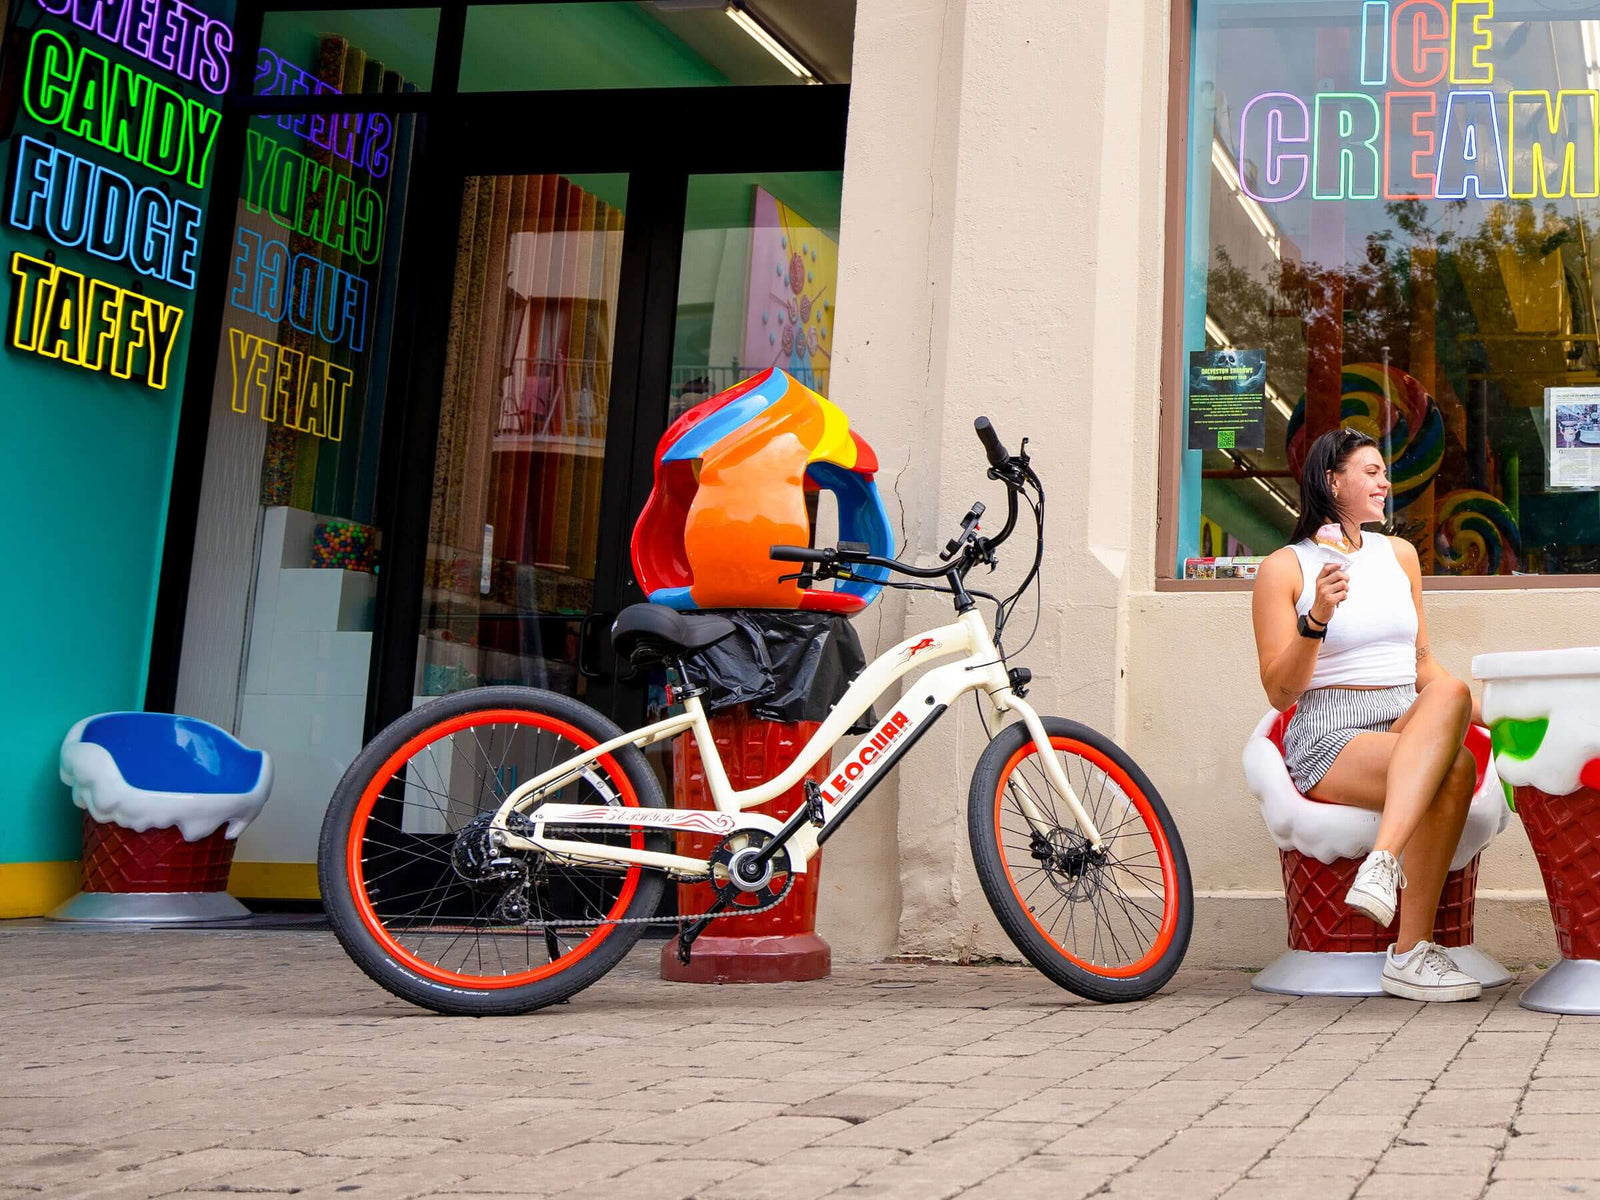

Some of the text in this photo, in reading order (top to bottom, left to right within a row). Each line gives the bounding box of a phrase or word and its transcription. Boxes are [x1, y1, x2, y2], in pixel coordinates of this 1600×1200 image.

[24, 29, 222, 189] CANDY
[1360, 0, 1494, 87] ICE
[10, 135, 202, 290] FUDGE
[1239, 89, 1600, 203] CREAM
[12, 252, 183, 390] TAFFY
